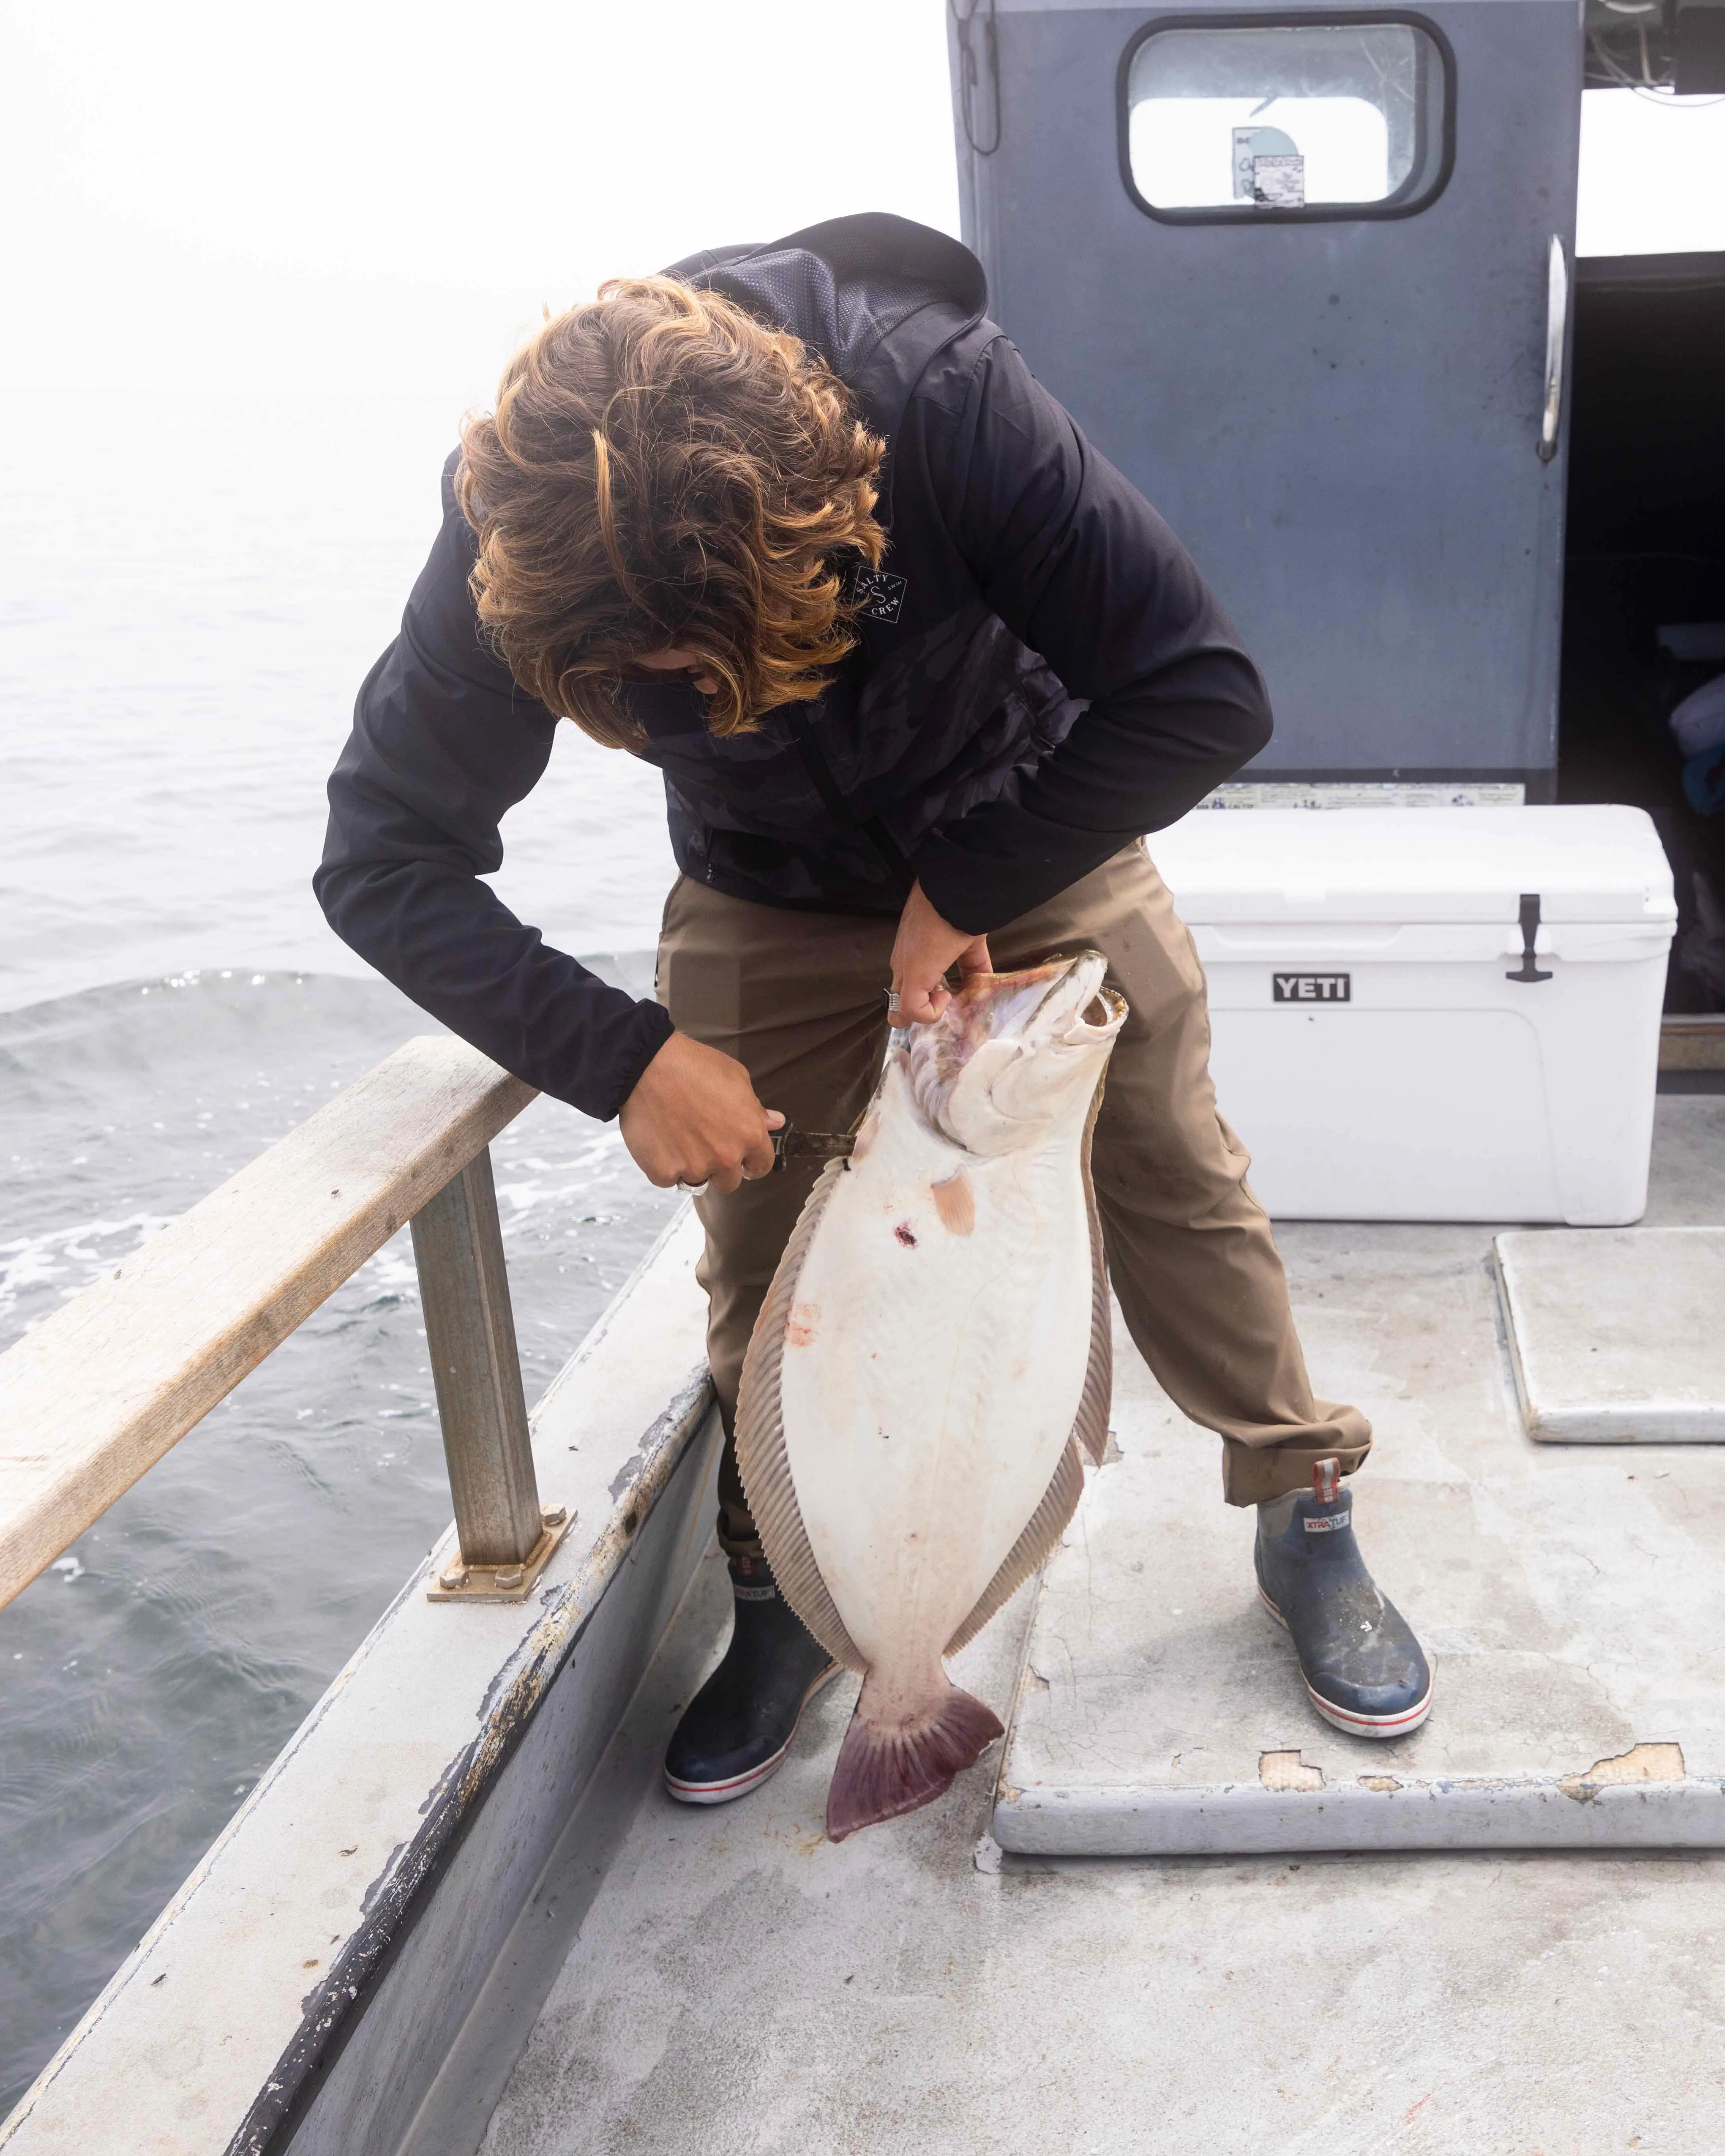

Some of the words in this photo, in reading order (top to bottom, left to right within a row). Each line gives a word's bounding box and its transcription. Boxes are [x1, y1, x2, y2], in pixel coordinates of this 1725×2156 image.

[856, 575, 888, 594] SALTY
[888, 581, 902, 590] SWIM
[871, 597, 899, 615] CREW
[1276, 977, 1345, 998] YETI
[1307, 1516, 1346, 1529] XTRATUF
